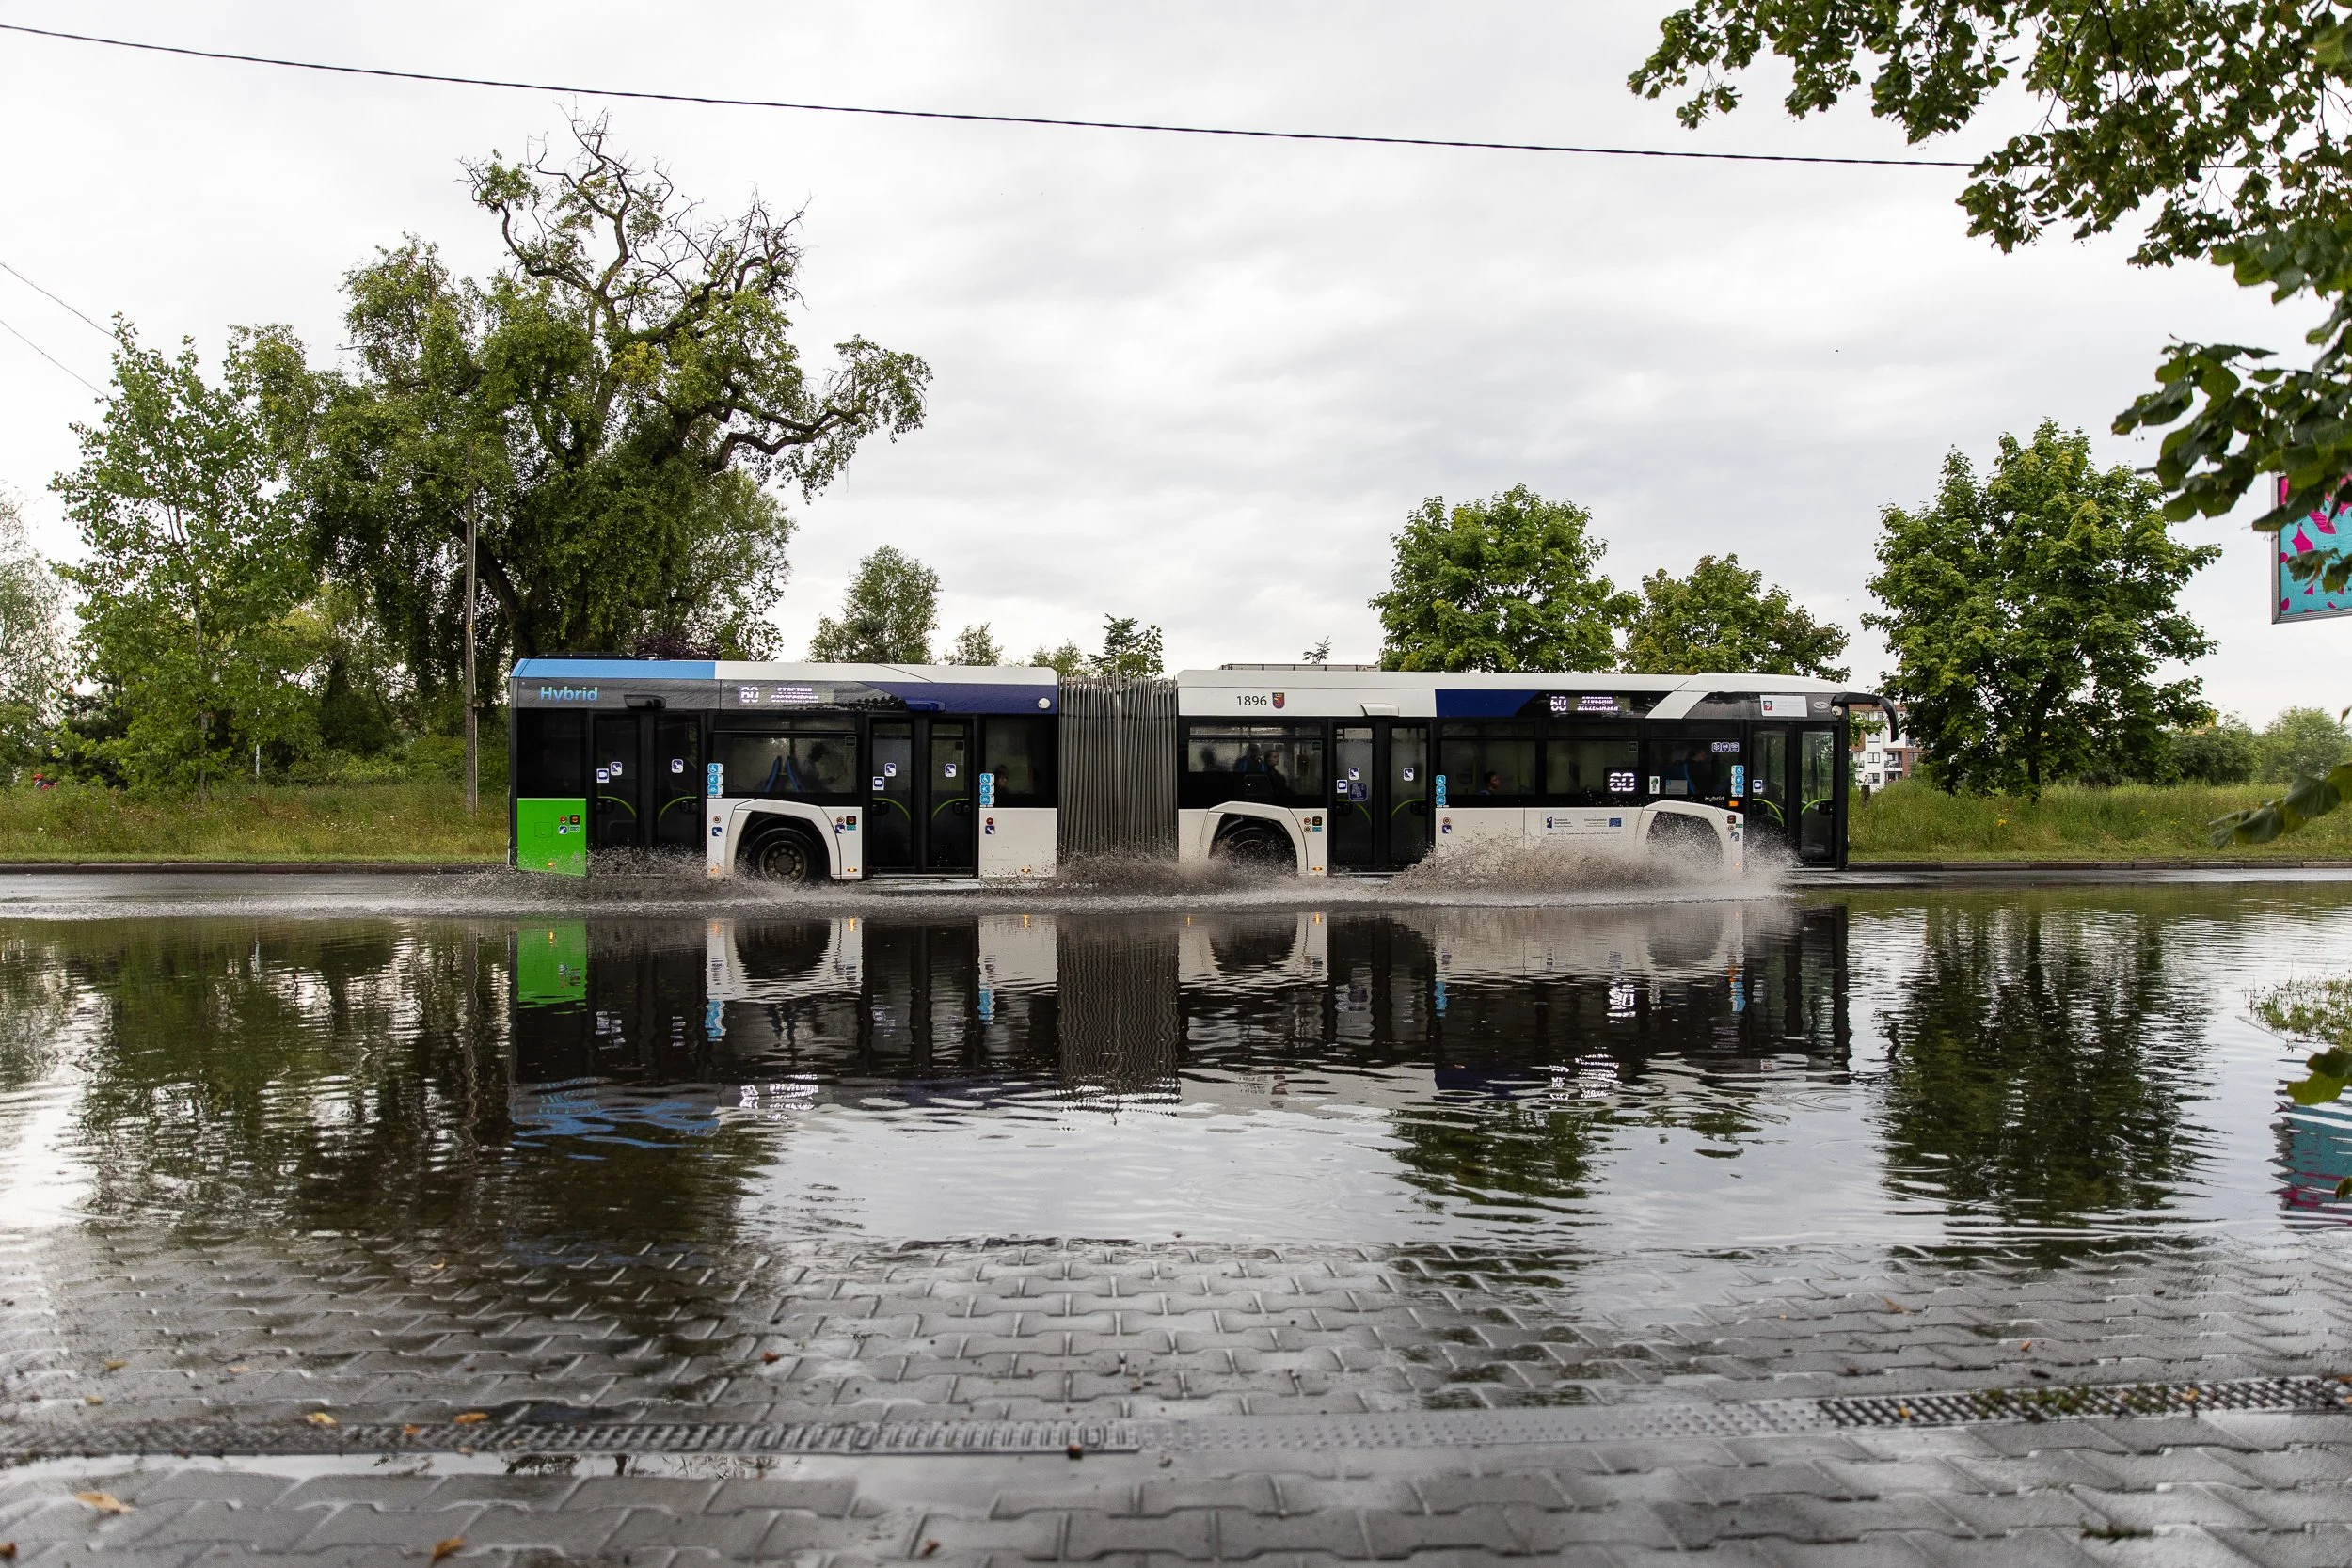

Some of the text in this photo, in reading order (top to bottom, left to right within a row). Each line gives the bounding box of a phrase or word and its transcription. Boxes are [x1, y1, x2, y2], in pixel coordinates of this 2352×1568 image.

[541, 686, 598, 703] Hybrid
[1237, 695, 1268, 706] 1896
[1550, 696, 1567, 712] 60
[1609, 772, 1635, 792] 60
